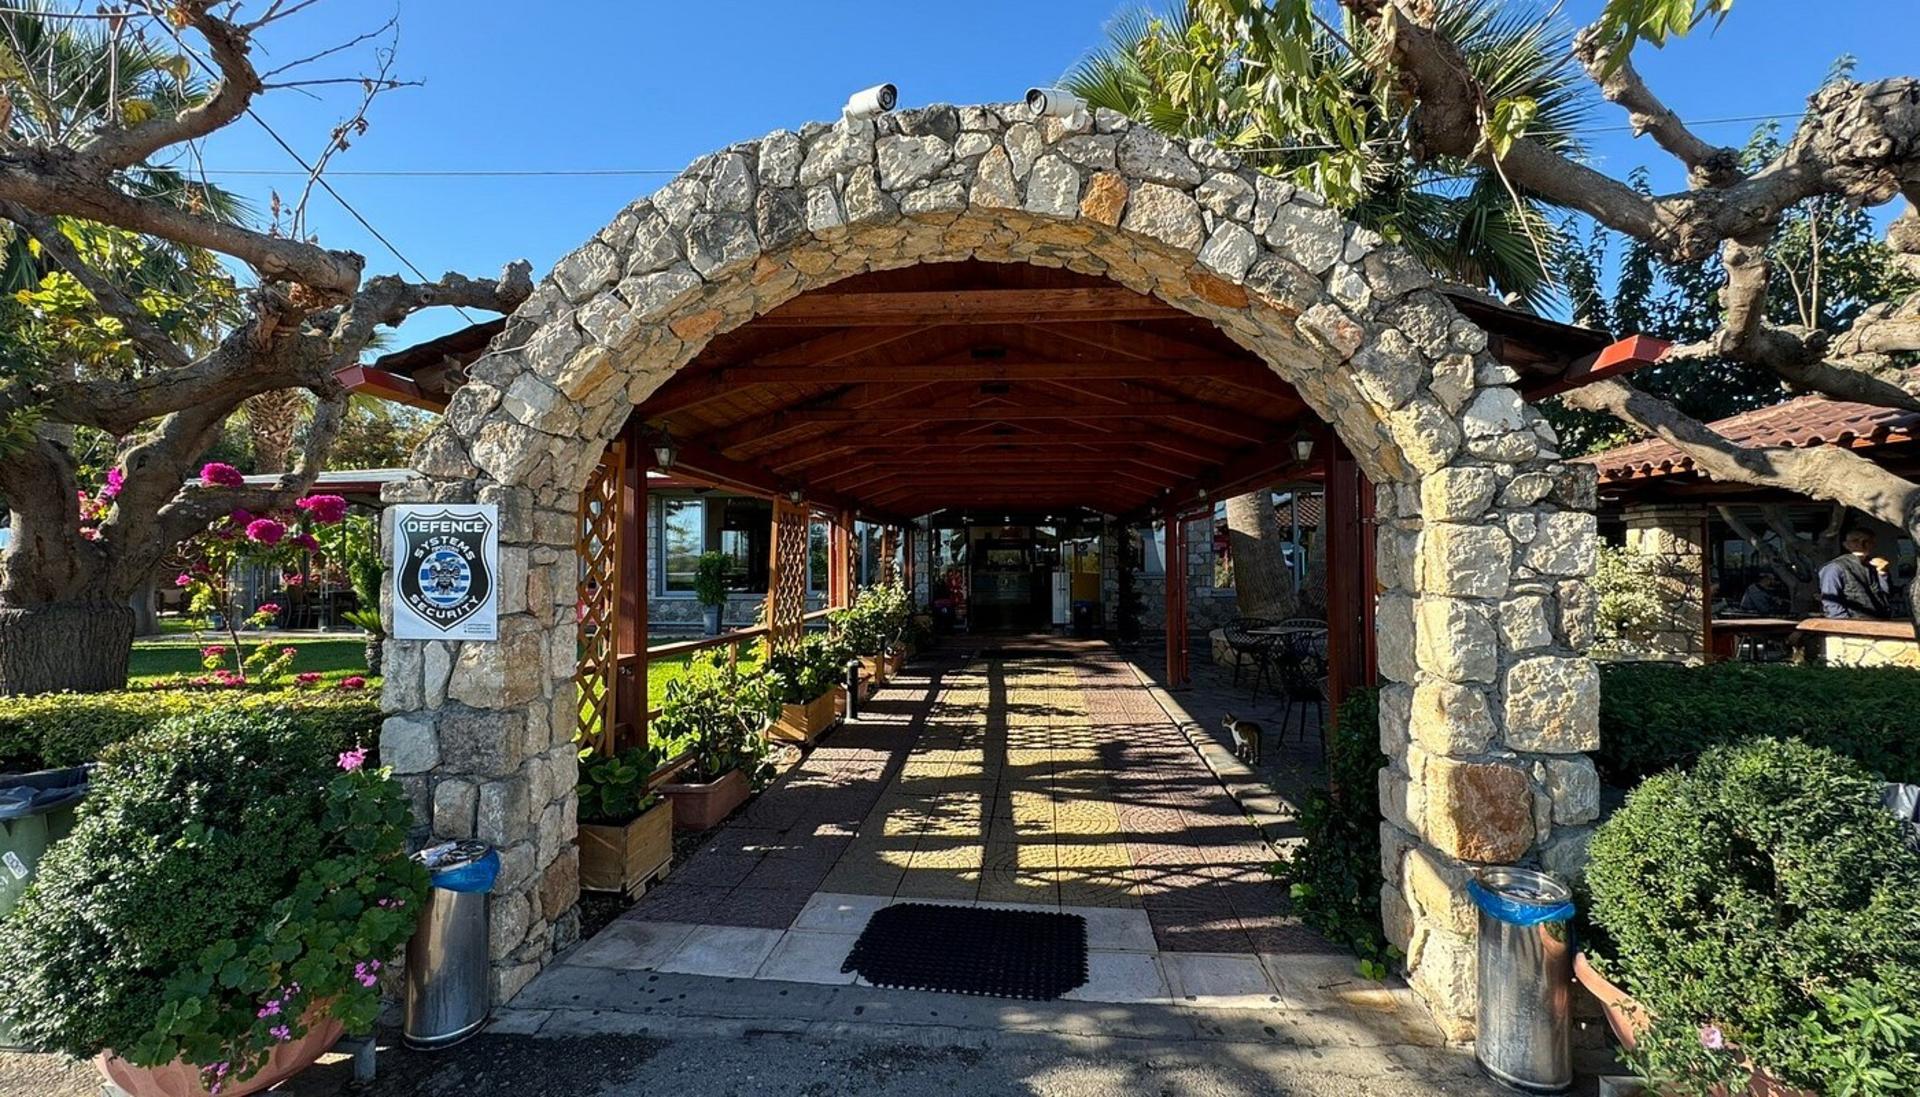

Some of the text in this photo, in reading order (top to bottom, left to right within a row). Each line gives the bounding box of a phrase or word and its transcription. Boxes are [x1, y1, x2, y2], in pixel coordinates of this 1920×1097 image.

[407, 521, 484, 533] DEFENCE
[414, 536, 476, 561] SYSTEMS
[409, 594, 478, 618] SECURITY
